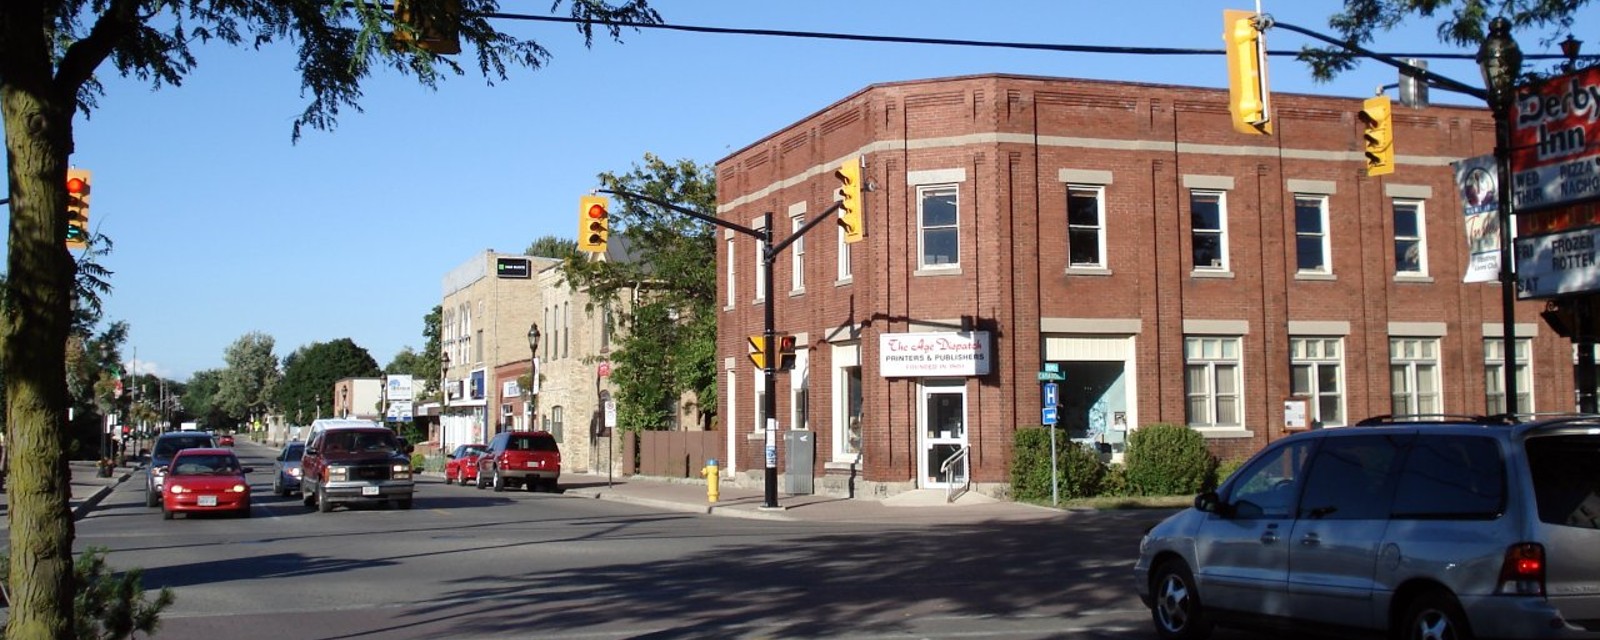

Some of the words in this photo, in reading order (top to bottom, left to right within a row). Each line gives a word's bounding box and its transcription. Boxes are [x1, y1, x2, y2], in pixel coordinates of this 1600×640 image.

[1517, 77, 1600, 125] Derby
[1539, 122, 1586, 157] Inn
[1516, 170, 1540, 188] WED
[1560, 160, 1593, 180] PIZZA
[1514, 187, 1544, 207] THUR
[1552, 234, 1595, 255] FROZEN
[1552, 251, 1596, 272] ROTTEN
[1518, 276, 1539, 293] SAT
[888, 338, 908, 352] The
[911, 338, 934, 353] Age
[936, 338, 982, 352] Dispatch
[885, 354, 925, 362] PRINTERS
[934, 353, 985, 361] PUBLISHERS
